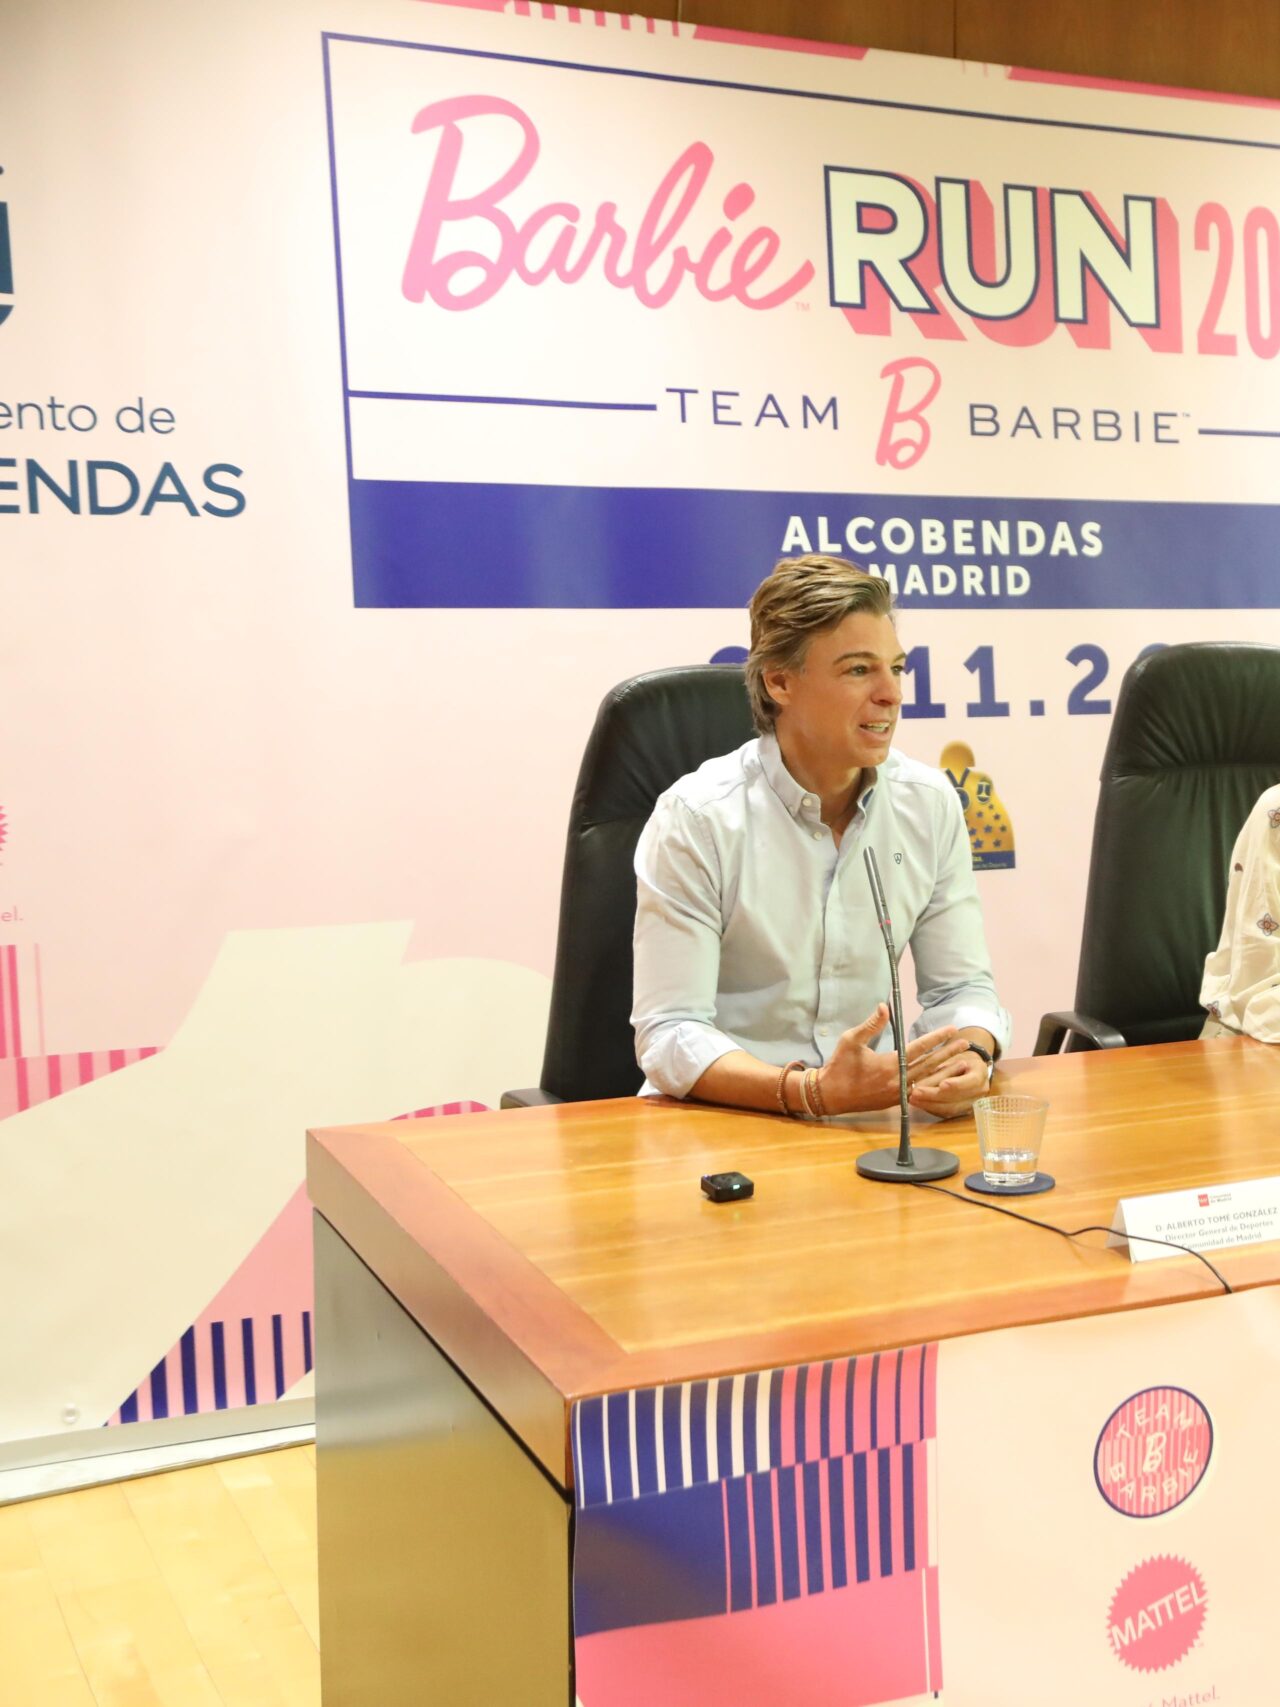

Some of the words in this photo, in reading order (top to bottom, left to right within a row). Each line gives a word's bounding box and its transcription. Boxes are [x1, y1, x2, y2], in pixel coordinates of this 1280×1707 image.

[402, 94, 816, 312] Barbie
[823, 164, 1184, 354] RUN
[116, 397, 176, 434] de
[666, 387, 839, 431] TEAM
[875, 356, 941, 470] B
[968, 402, 1180, 444] BARBIE
[781, 515, 1104, 557] ALCOBENDAS
[868, 563, 1032, 597] MADRID
[1166, 1217, 1205, 1231] ALBERTO
[1198, 1224, 1228, 1237] General
[1229, 1223, 1238, 1232] de
[1239, 1219, 1274, 1231] Deportes
[1236, 1230, 1262, 1241] Madrid
[1111, 1581, 1208, 1651] MATTEL
